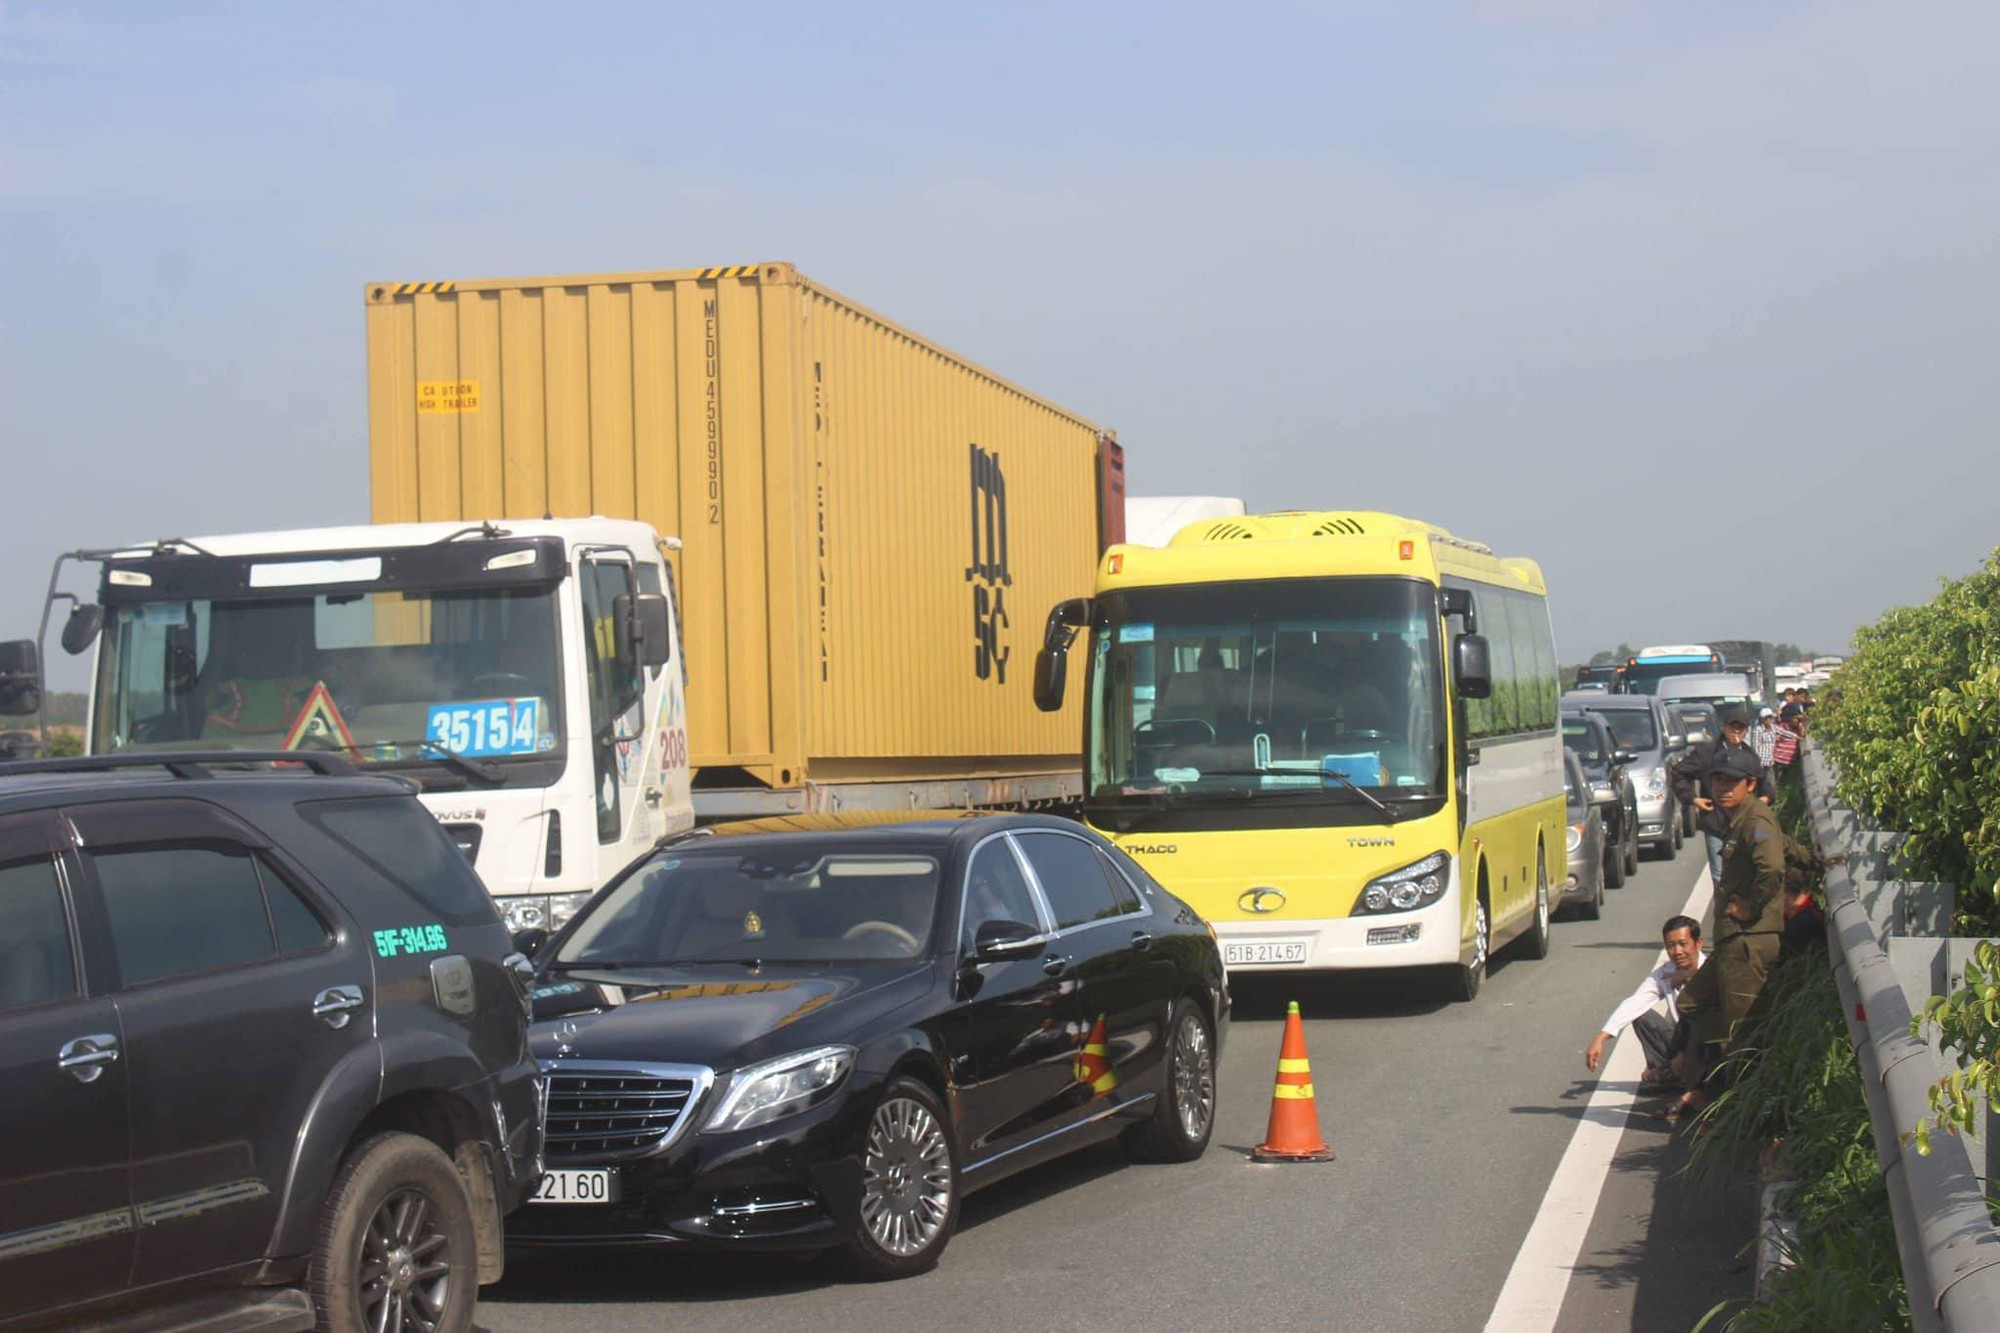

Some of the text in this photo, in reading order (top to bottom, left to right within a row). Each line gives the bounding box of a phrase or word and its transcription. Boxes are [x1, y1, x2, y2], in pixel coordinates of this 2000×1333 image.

[432, 706, 533, 753] 35154
[660, 728, 687, 770] 208
[1125, 844, 1178, 854] THACO
[1347, 837, 1395, 847] TOWN
[532, 1173, 605, 1199] 21.60
